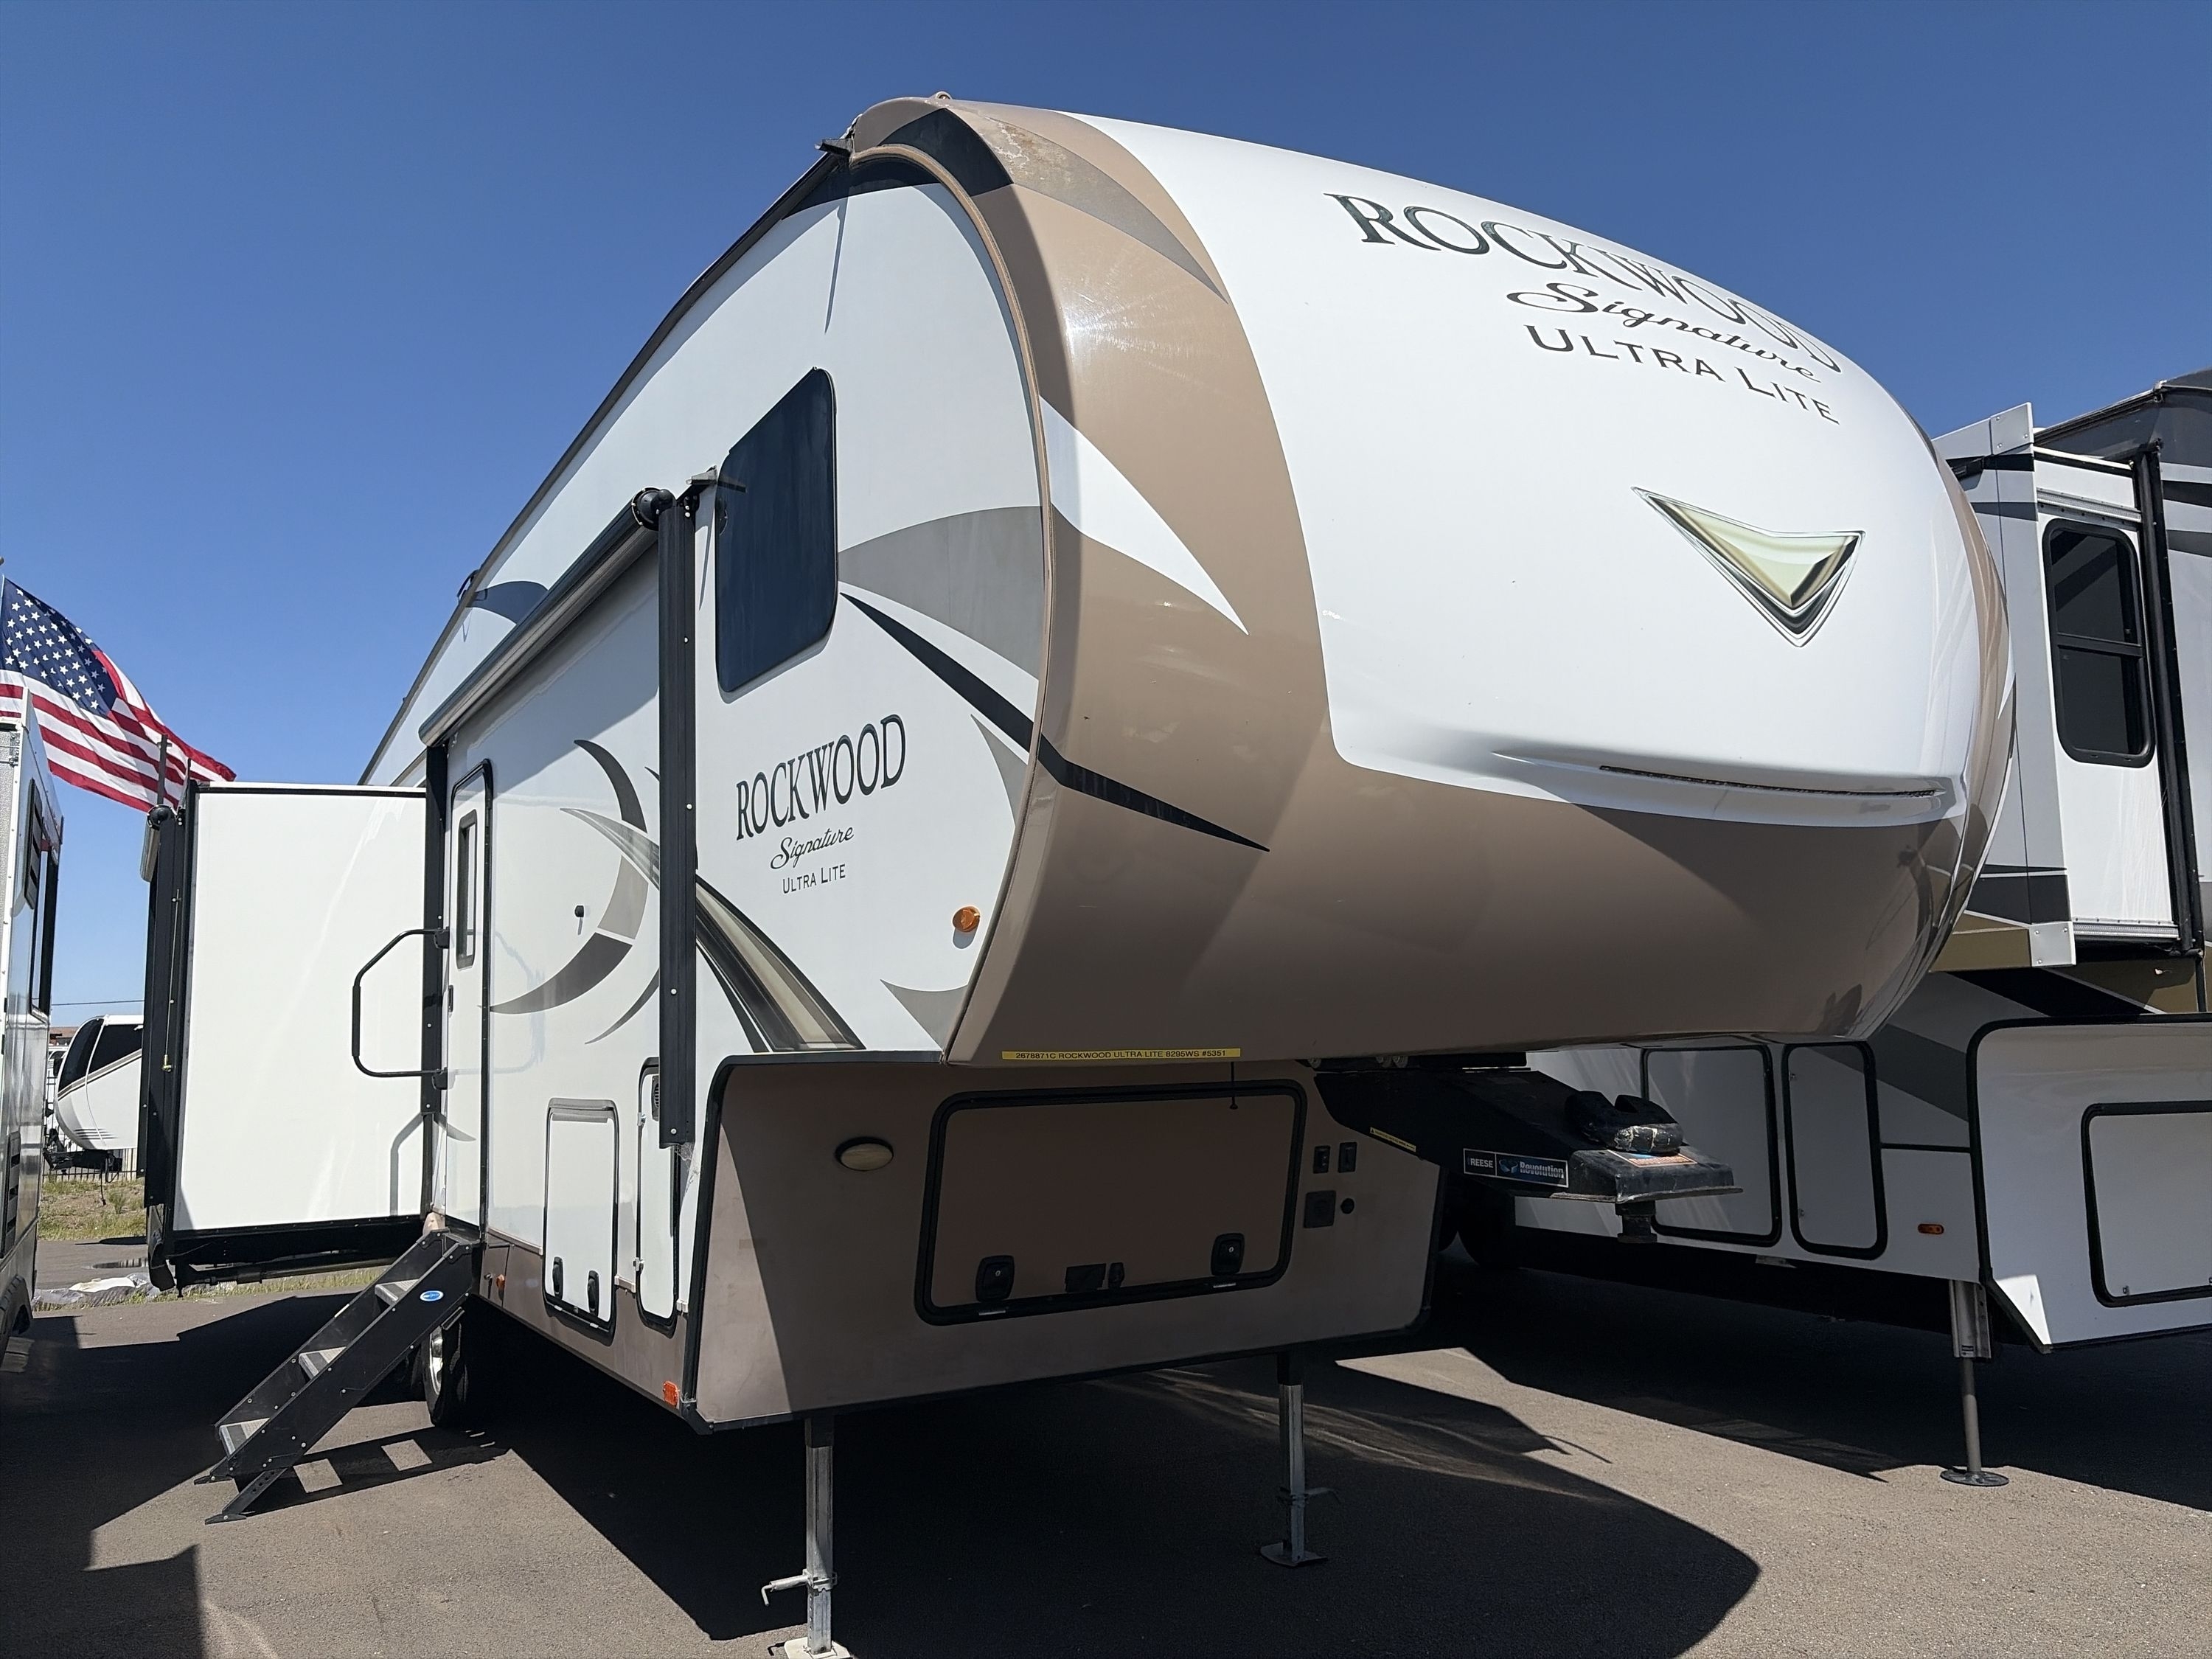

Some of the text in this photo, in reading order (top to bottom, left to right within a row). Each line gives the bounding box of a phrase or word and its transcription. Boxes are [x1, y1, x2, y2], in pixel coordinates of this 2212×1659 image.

[1324, 193, 1841, 373] ROCKWOOD
[1506, 282, 1822, 383] Signature
[1523, 324, 1840, 425] ULTRA LITE
[736, 714, 906, 841] ROCKWOOD
[770, 827, 855, 869] Signature
[782, 863, 846, 894] ULTRA LITE
[1058, 1051, 1112, 1059] ROCKWOOD
[1113, 1050, 1143, 1058] ULTRA
[1470, 1157, 1494, 1169] REESE
[1519, 1161, 1565, 1179] Revolution
